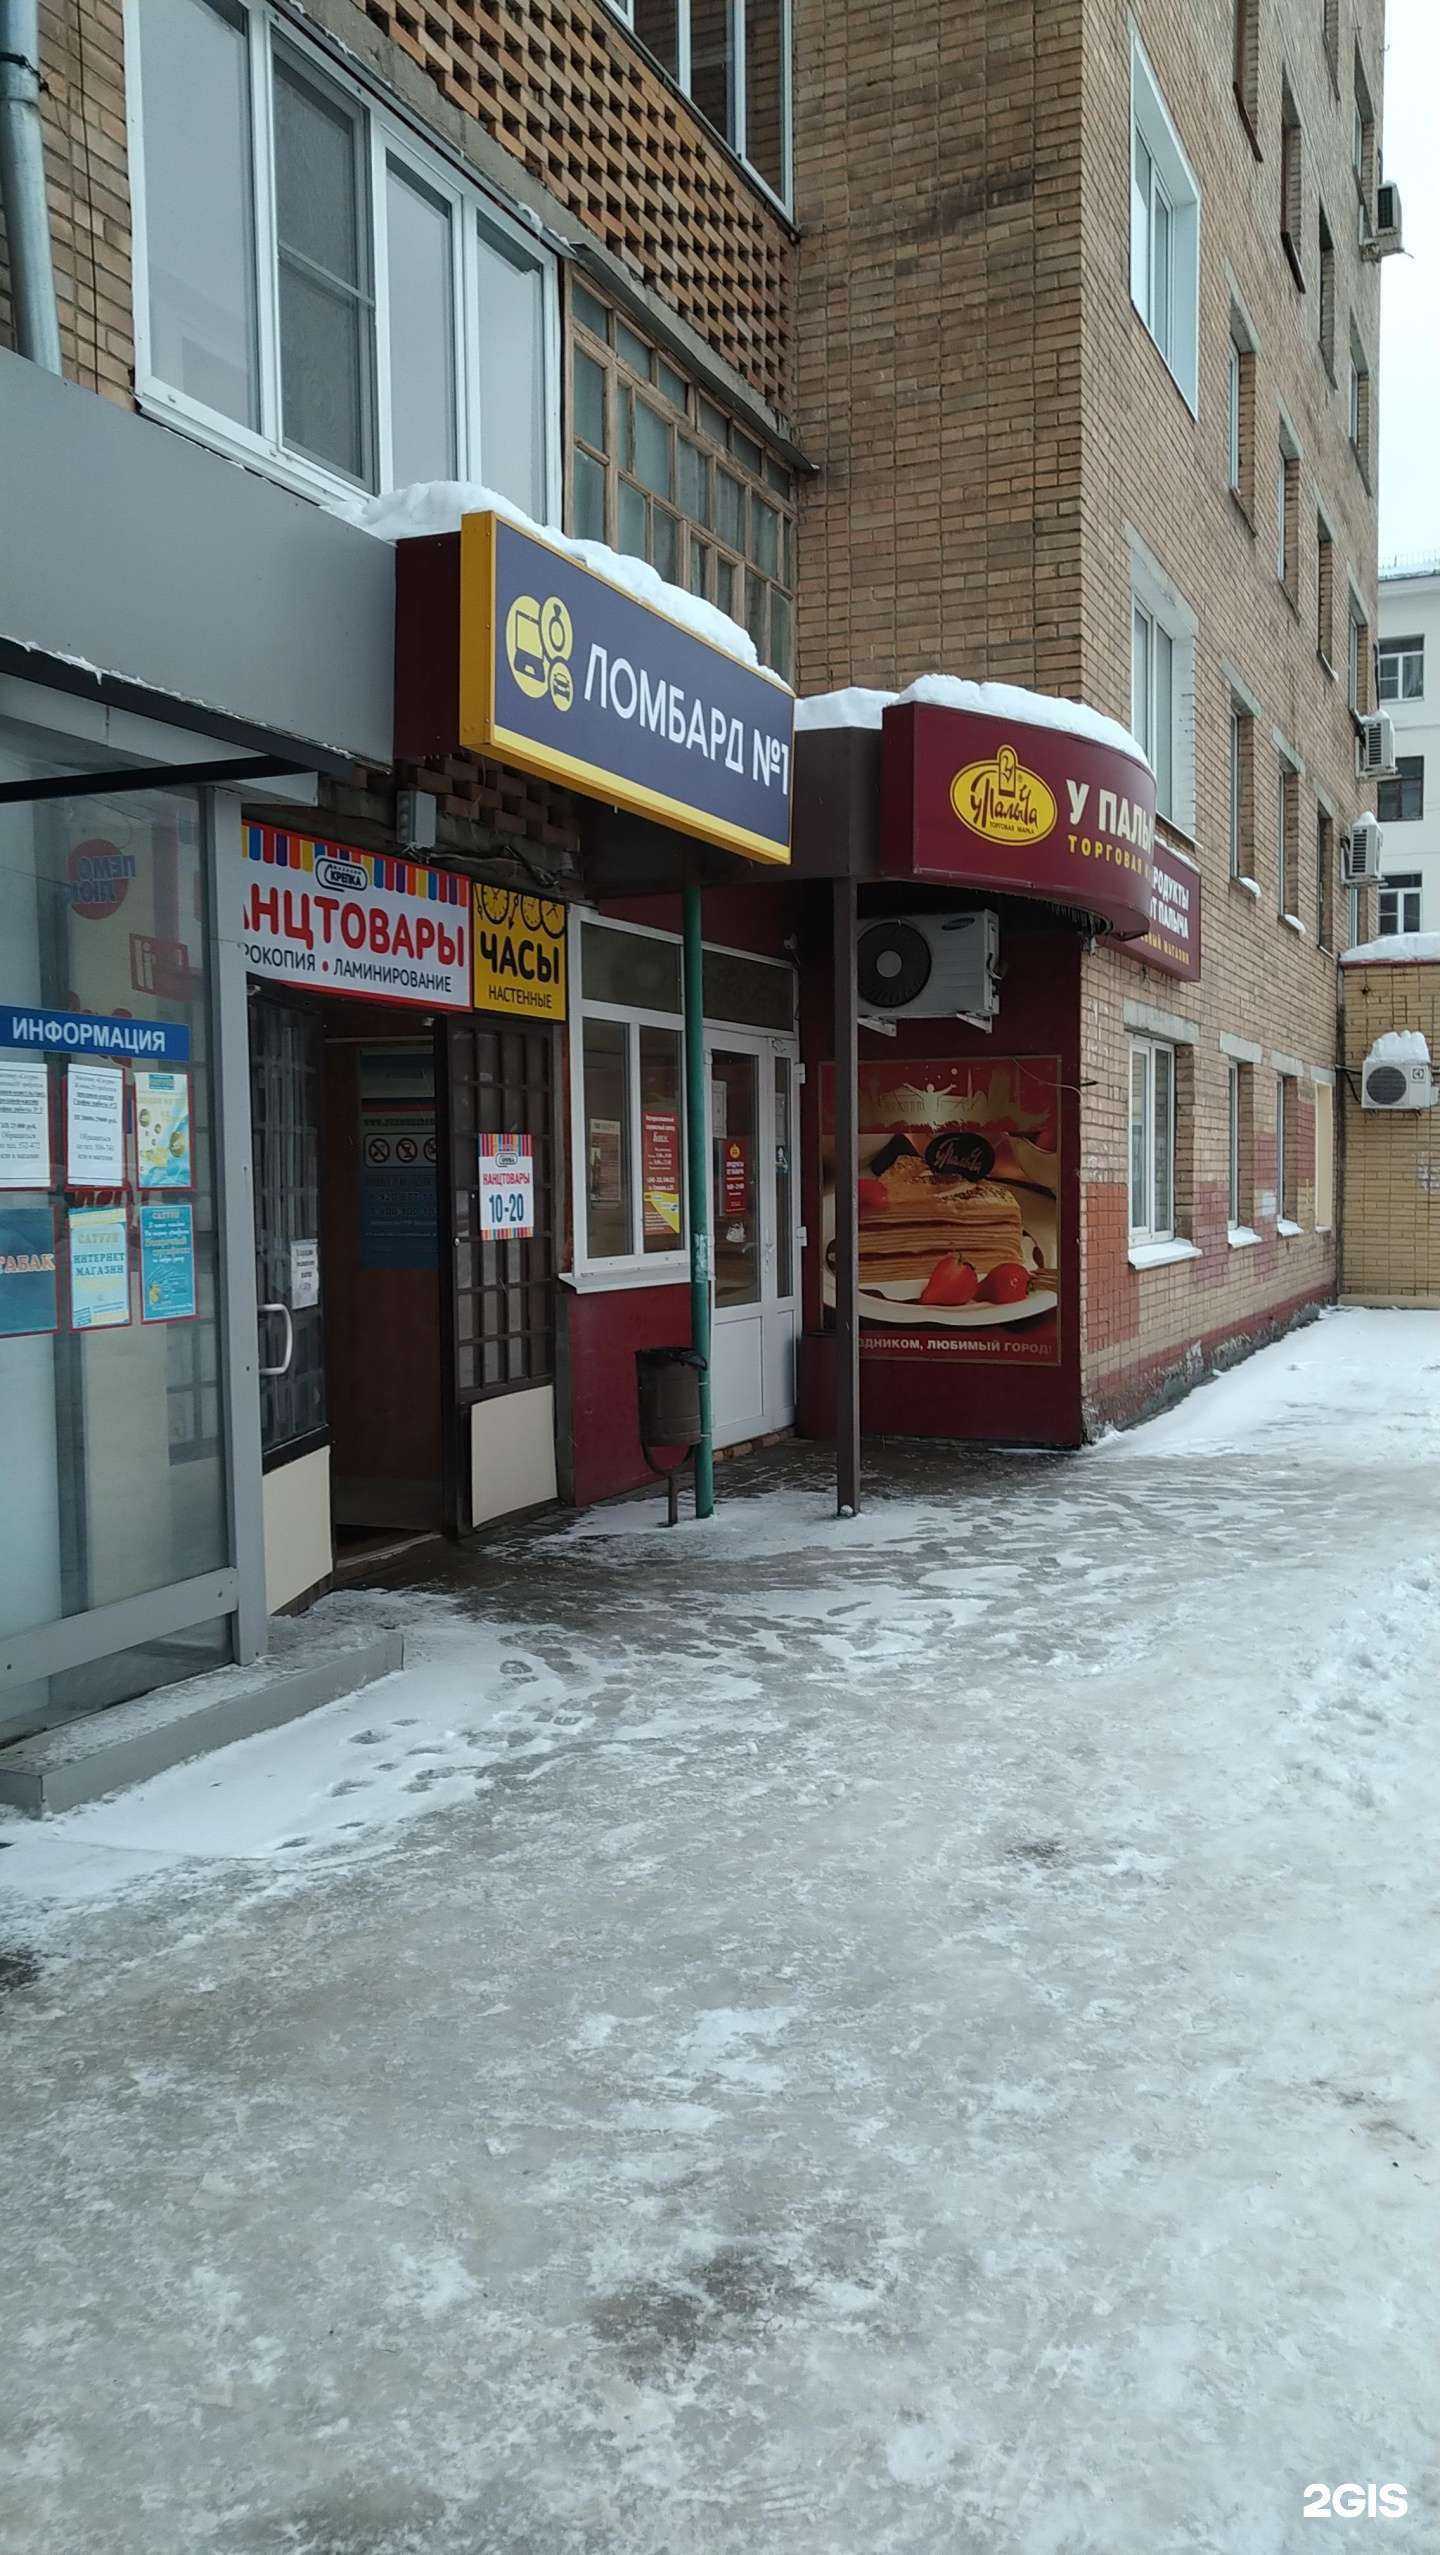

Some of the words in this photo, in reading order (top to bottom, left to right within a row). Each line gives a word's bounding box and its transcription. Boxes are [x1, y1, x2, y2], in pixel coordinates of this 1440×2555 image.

[584, 643, 745, 774] ЛОМБАРД
[753, 728, 790, 796] №1
[1066, 778, 1090, 825] У
[1067, 834, 1142, 876] ТОРГОВАЯ
[330, 870, 362, 887] КРЕПКА
[480, 930, 560, 985] ЧАСЫ
[333, 958, 452, 992] ЛАМИНИРОВАНИЕ
[488, 984, 553, 1009] НАСТЕННЫЕ
[12, 1016, 166, 1053] ИНФОРМАЦИЯ
[483, 1172, 531, 1185] КАНЦТОВАРЫ
[489, 1193, 525, 1223] 10-20
[73, 1252, 125, 1264] ИНТЕРНЕТ
[76, 1264, 124, 1276] МАГАЗИН
[927, 1338, 1001, 1352] ЛЮБИМЫЙ
